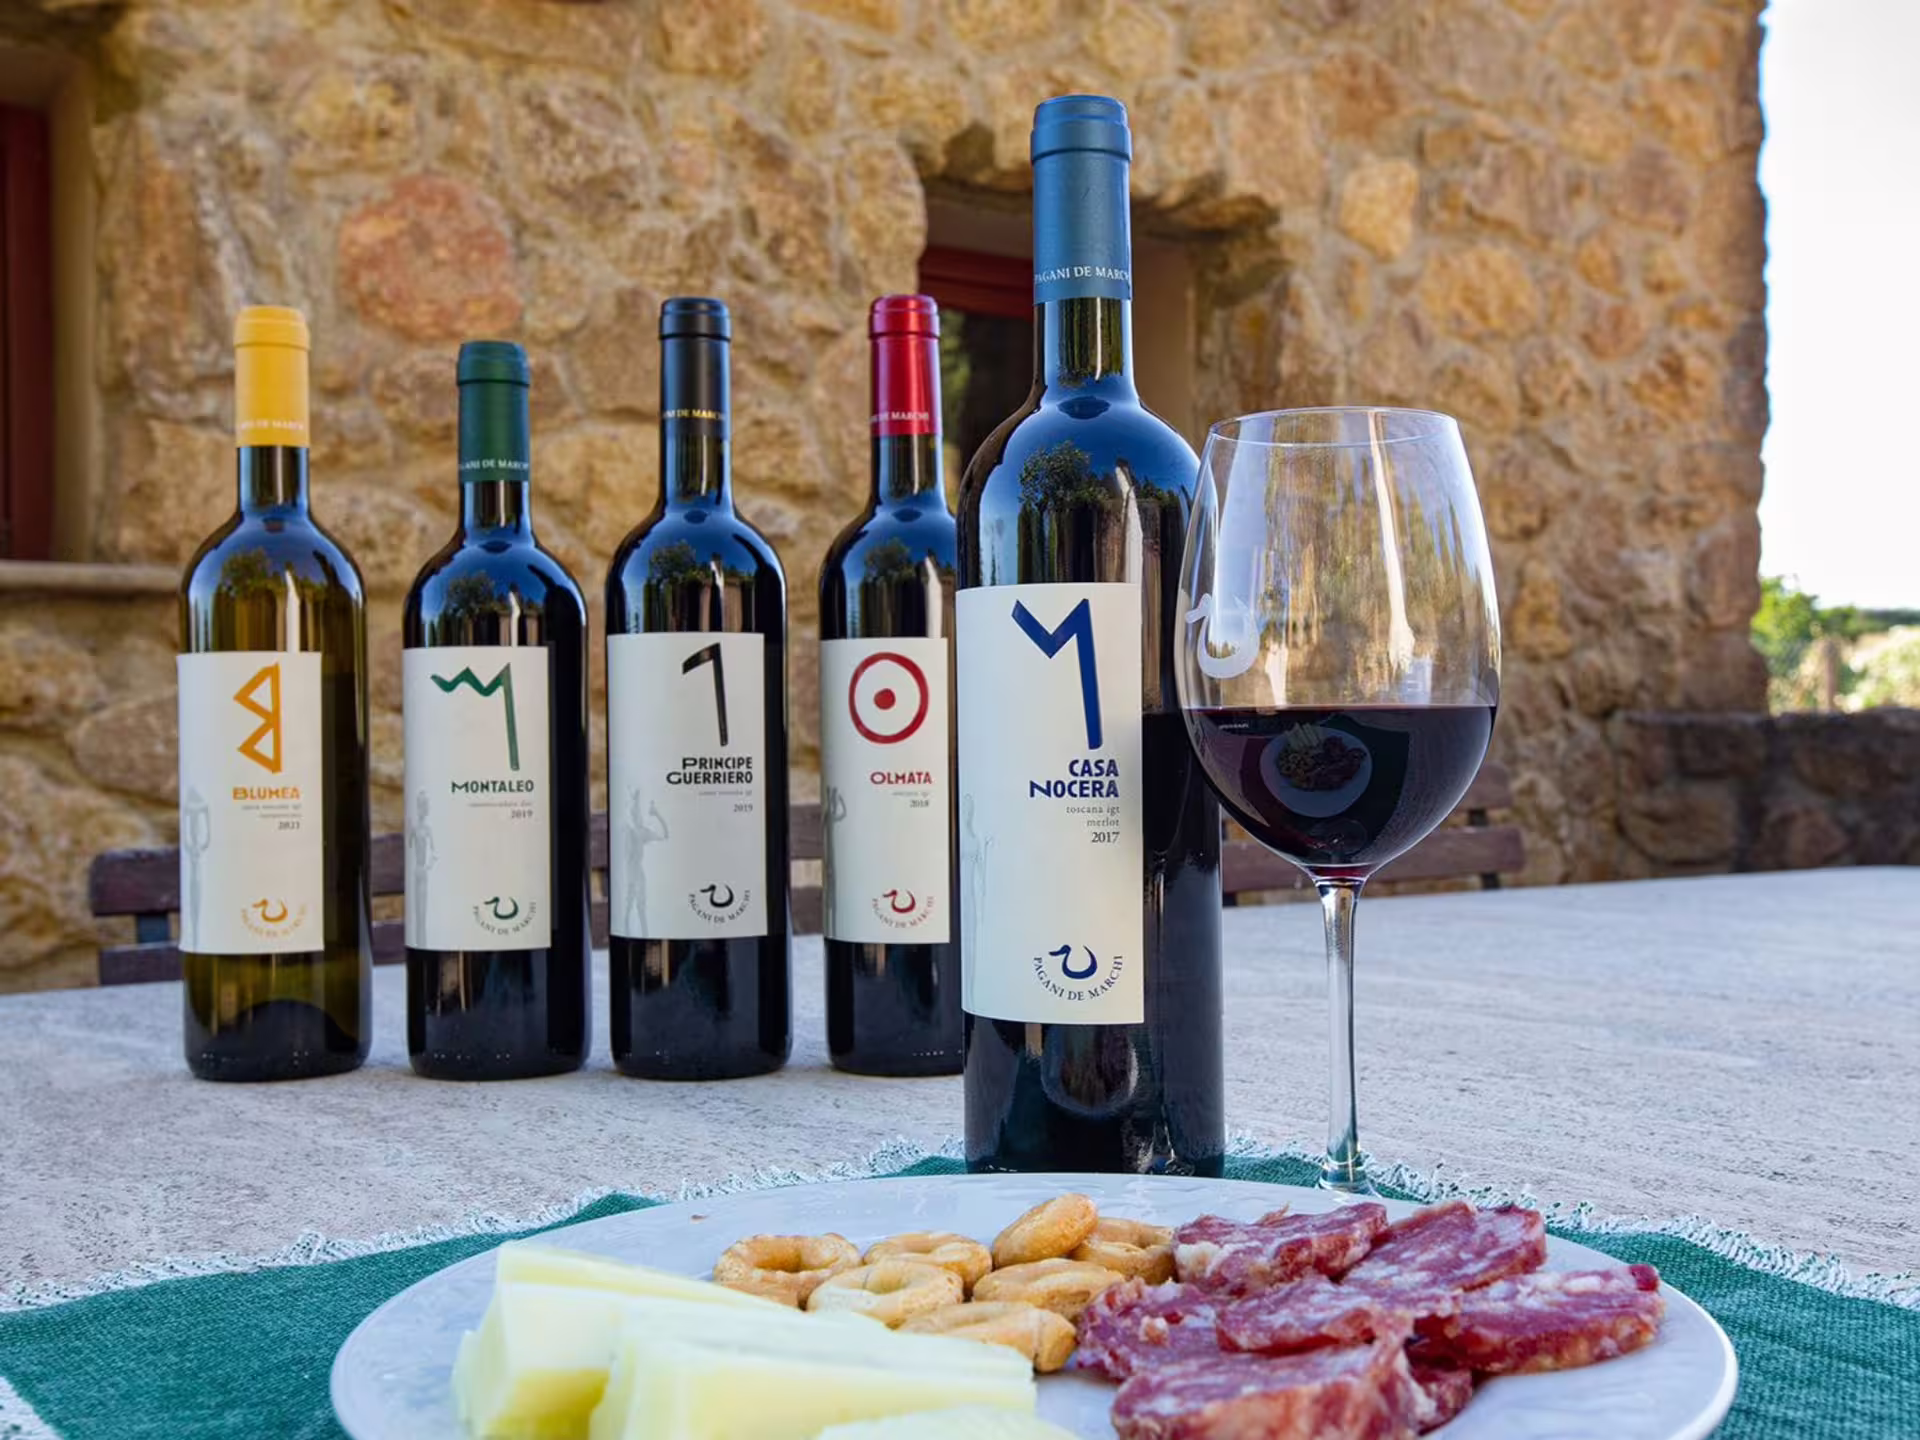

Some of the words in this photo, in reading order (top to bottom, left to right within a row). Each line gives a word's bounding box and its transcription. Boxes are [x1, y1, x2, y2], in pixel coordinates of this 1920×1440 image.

[1073, 266, 1092, 278] DE
[482, 458, 495, 469] DE
[682, 756, 753, 770] PRINCIPE
[1068, 759, 1119, 778] CASA
[666, 771, 753, 785] GUERRIERO
[870, 771, 932, 785] OLMATA
[451, 780, 534, 793] MONTALEO
[1029, 780, 1120, 799] NOCERA
[232, 786, 300, 801] BLUMEA
[511, 809, 533, 819] 2019
[733, 803, 753, 813] 2019
[1066, 806, 1104, 814] toscana
[1106, 805, 1120, 817] igt
[1086, 817, 1120, 827] merlot
[1091, 831, 1120, 844] 2017
[1033, 957, 1065, 998] PAGANI
[1067, 990, 1086, 1001] DE
[1088, 955, 1123, 999] MARCHI
